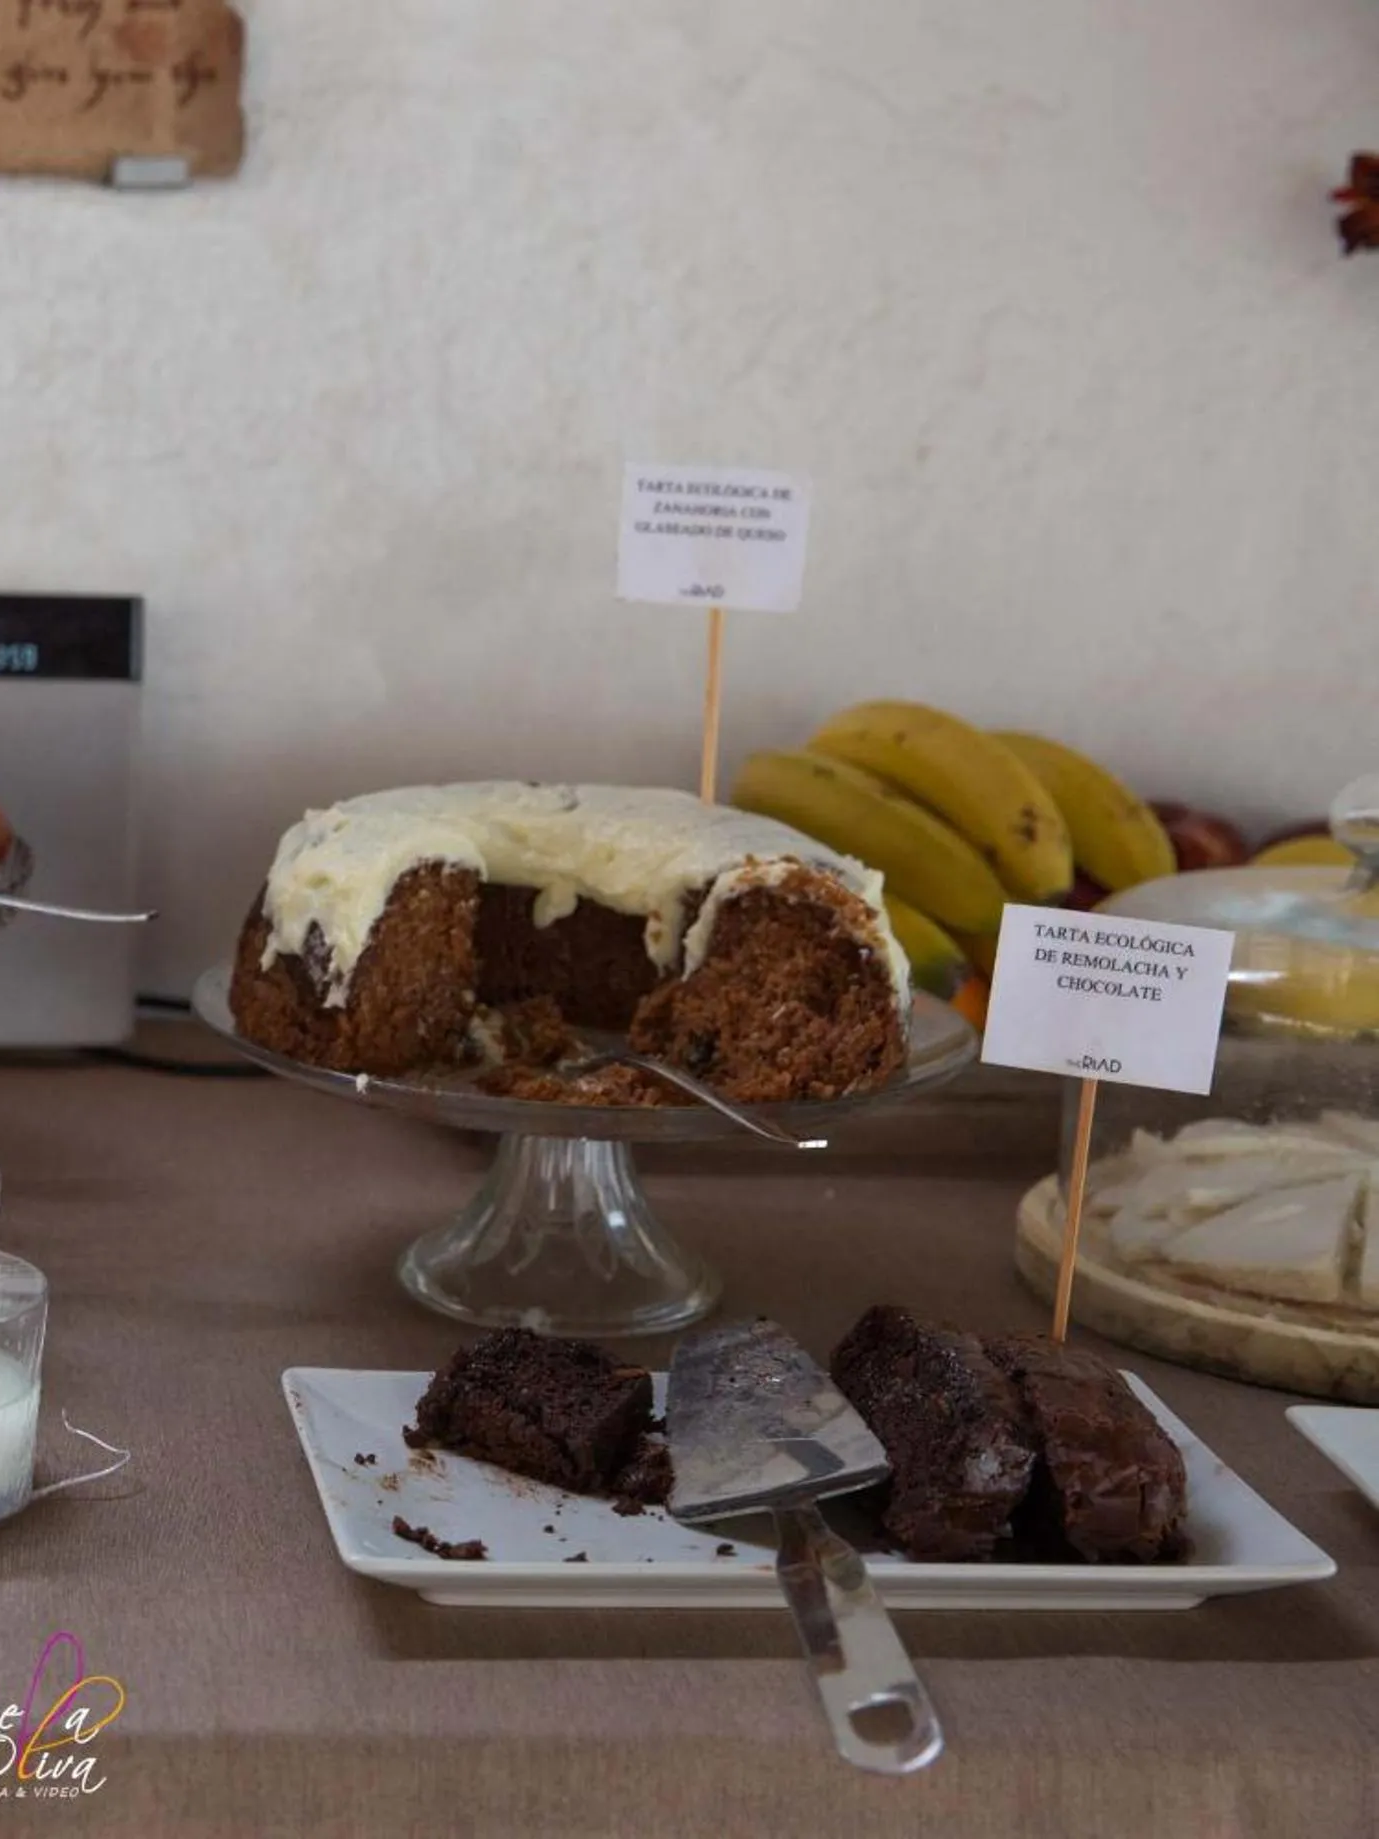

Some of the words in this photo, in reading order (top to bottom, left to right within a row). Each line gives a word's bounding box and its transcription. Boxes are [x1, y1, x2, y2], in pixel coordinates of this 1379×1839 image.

[1034, 924, 1090, 945] TARTA
[1094, 931, 1195, 957] ECOLÓGICA
[1034, 948, 1058, 963] DE
[1061, 952, 1170, 979] REMOLACHA
[1175, 966, 1189, 981] Y
[1057, 975, 1163, 1001] CHOCOLATE
